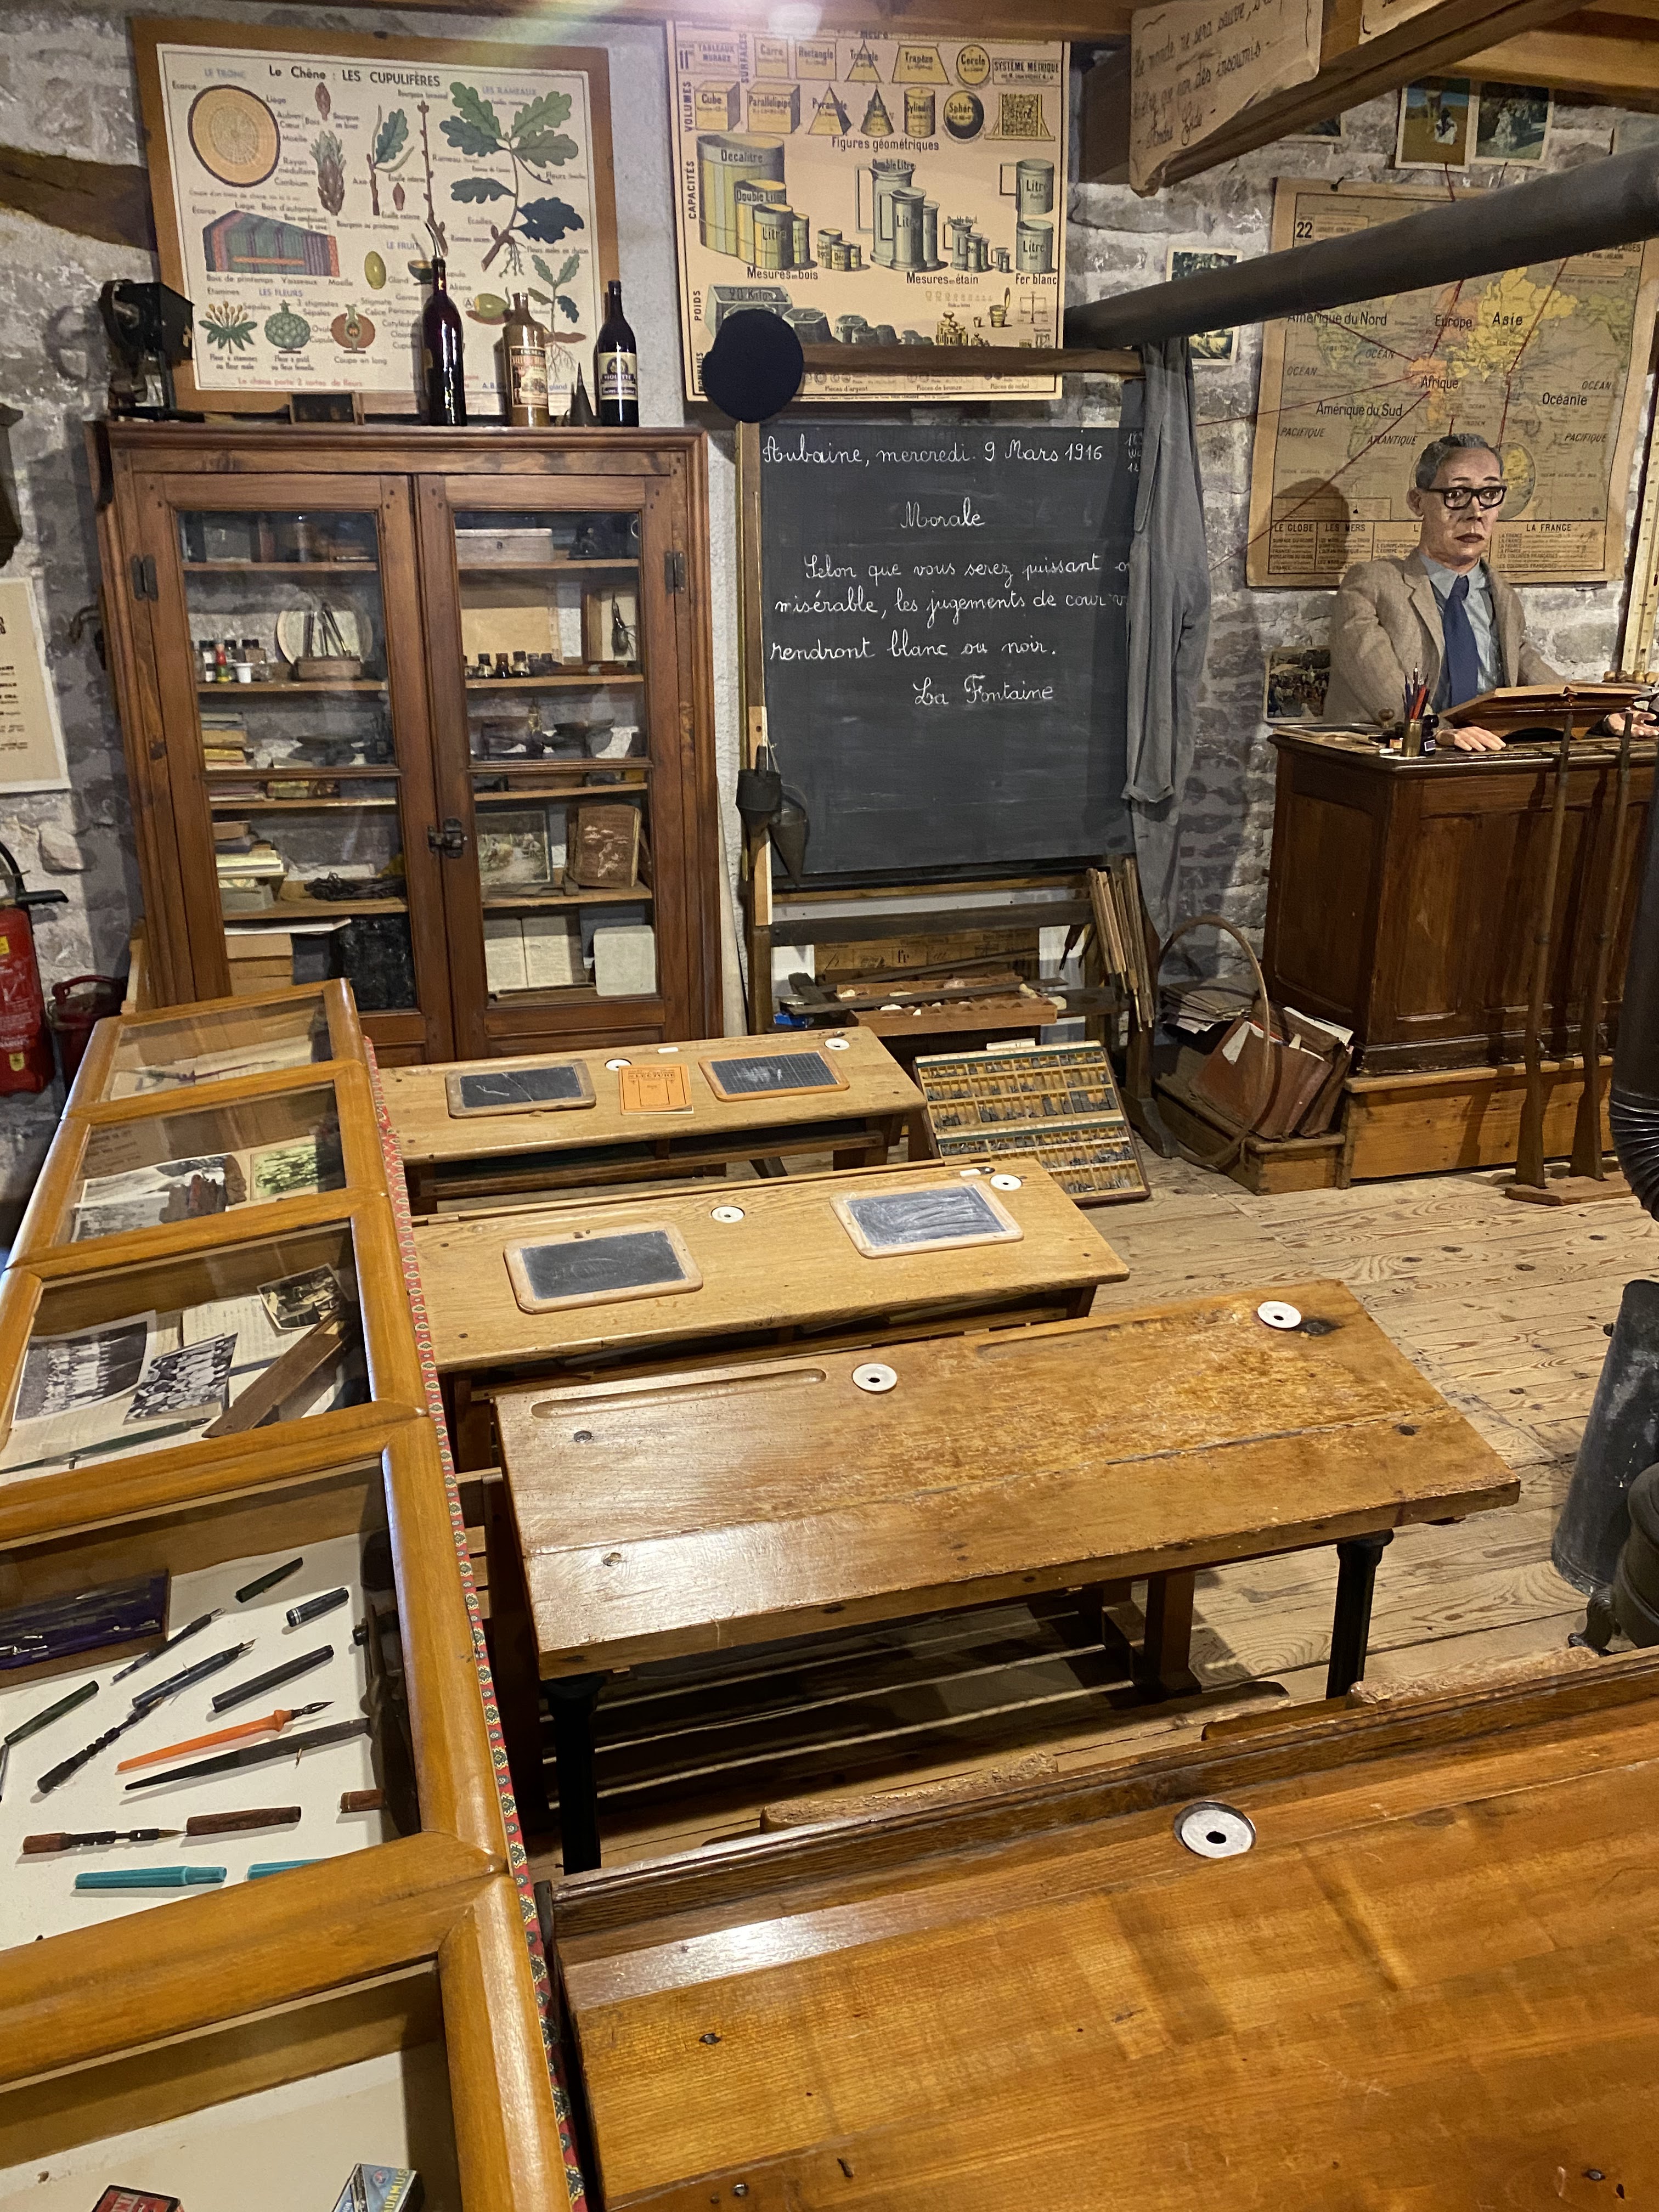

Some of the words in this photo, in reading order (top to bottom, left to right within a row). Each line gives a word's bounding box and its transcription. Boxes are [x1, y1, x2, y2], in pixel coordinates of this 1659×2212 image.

[269, 65, 282, 77] Le
[291, 66, 326, 80] Chêne
[342, 70, 361, 82] LES
[370, 71, 441, 87] CUPULIFÈRES
[683, 81, 692, 133] VOLUMES
[702, 93, 722, 105] Cube
[832, 136, 870, 153] Figures
[872, 138, 939, 153] géométriques
[736, 190, 764, 202] Double
[762, 225, 787, 241] Litre
[1296, 221, 1313, 239] 22
[1023, 240, 1045, 253] Litre
[747, 266, 791, 280] Mesures
[798, 269, 819, 280] bois
[906, 272, 949, 285] Mesures
[956, 273, 979, 285] étain
[1015, 273, 1031, 285] Fer
[1032, 274, 1058, 285] blanc
[693, 290, 702, 321] POIDS
[1287, 311, 1342, 328] Amérique
[1344, 311, 1358, 325] du
[1360, 311, 1387, 326] Nord
[1434, 314, 1473, 332] Europe
[1491, 312, 1523, 326] Asie
[1420, 375, 1459, 390] Afrique
[1542, 392, 1588, 406] Océanie
[1316, 401, 1365, 417] Amérique
[1367, 403, 1380, 416] du
[1381, 403, 1403, 416] Sud
[1367, 435, 1418, 446] ATLANTIQUE
[1565, 433, 1608, 443] PACIFIQUE
[763, 433, 870, 467] Aubaine,
[985, 441, 995, 462] 9
[1005, 439, 1059, 462] Mars
[1064, 443, 1103, 461] 1916
[900, 496, 985, 528] Morale
[1274, 523, 1284, 532] LE
[1288, 523, 1314, 532] GLOBE
[1325, 523, 1340, 532] LES
[1345, 523, 1365, 532] MERS
[1526, 524, 1536, 532] LA
[1541, 523, 1572, 532] FRANCE
[804, 554, 857, 579] Selon
[868, 563, 902, 586] que
[913, 563, 956, 577] vous
[964, 563, 1013, 589] serez
[1022, 552, 1102, 581] puissant
[775, 585, 887, 619] misérable,
[895, 586, 918, 612] les
[926, 590, 1025, 629] jugements
[1032, 589, 1057, 607] de
[1065, 594, 1107, 607] cour
[770, 636, 876, 661] rendront
[886, 628, 949, 657] blanc
[961, 641, 989, 655] ou
[1001, 634, 1056, 655] noir.
[913, 676, 950, 706] La
[963, 673, 1054, 704] Fontaine
